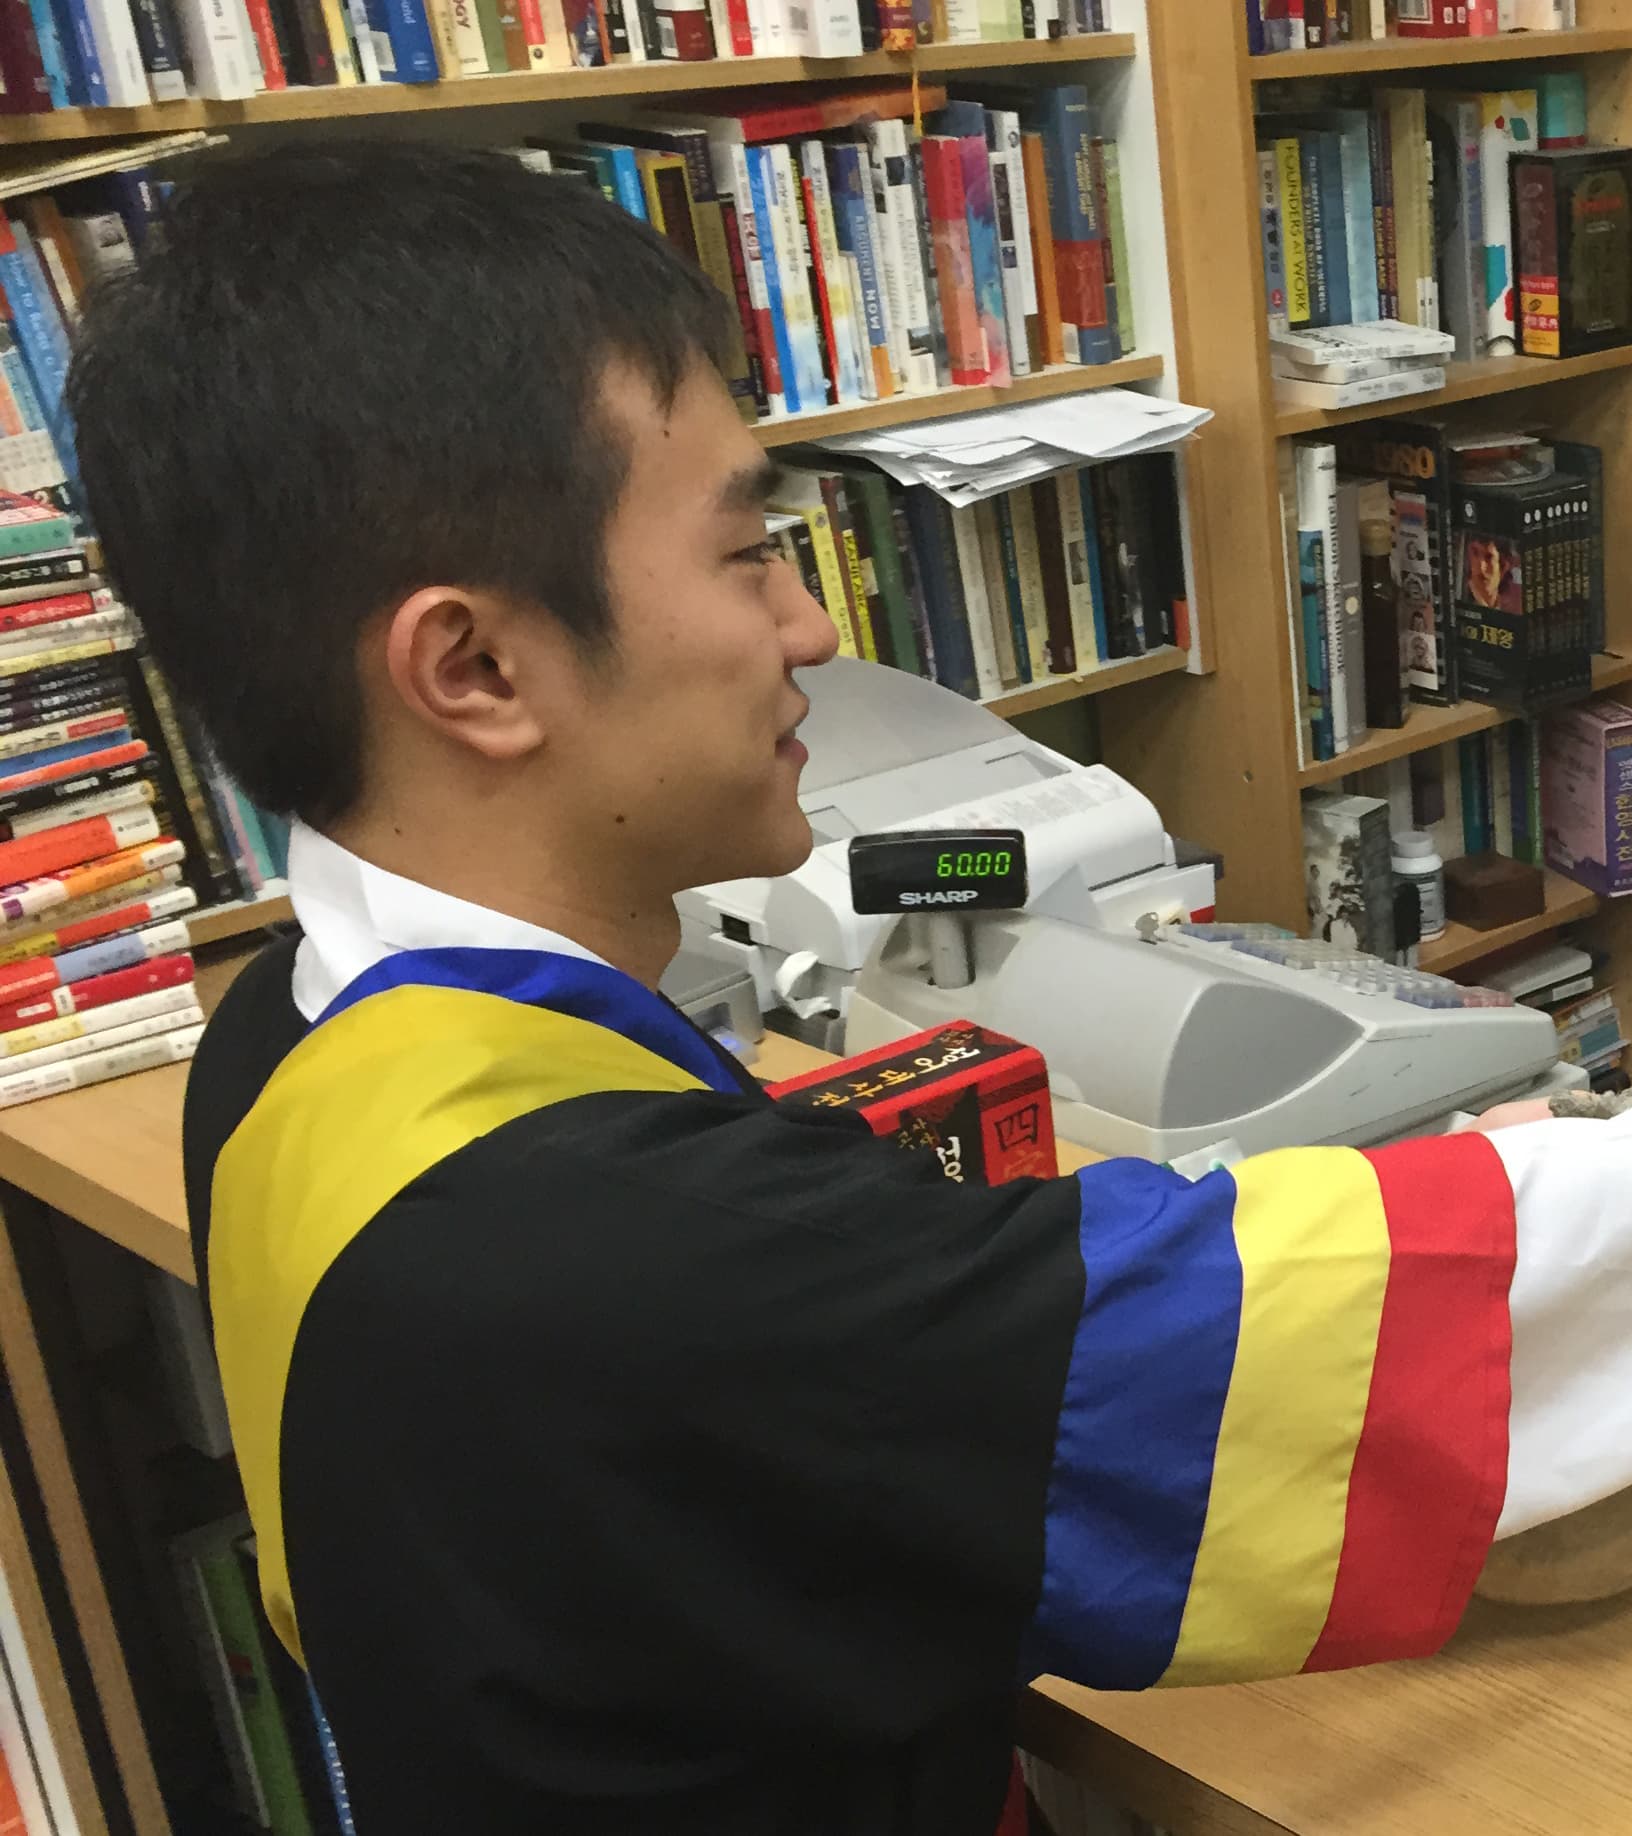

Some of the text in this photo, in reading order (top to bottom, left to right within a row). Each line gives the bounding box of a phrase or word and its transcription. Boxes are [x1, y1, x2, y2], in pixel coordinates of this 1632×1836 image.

[1284, 146, 1302, 236] FOUNDERS
[854, 215, 885, 330] ARGUMENT NOW
[1292, 261, 1308, 312] WORK
[936, 852, 1011, 879] 60.00
[899, 889, 978, 906] SHARP
